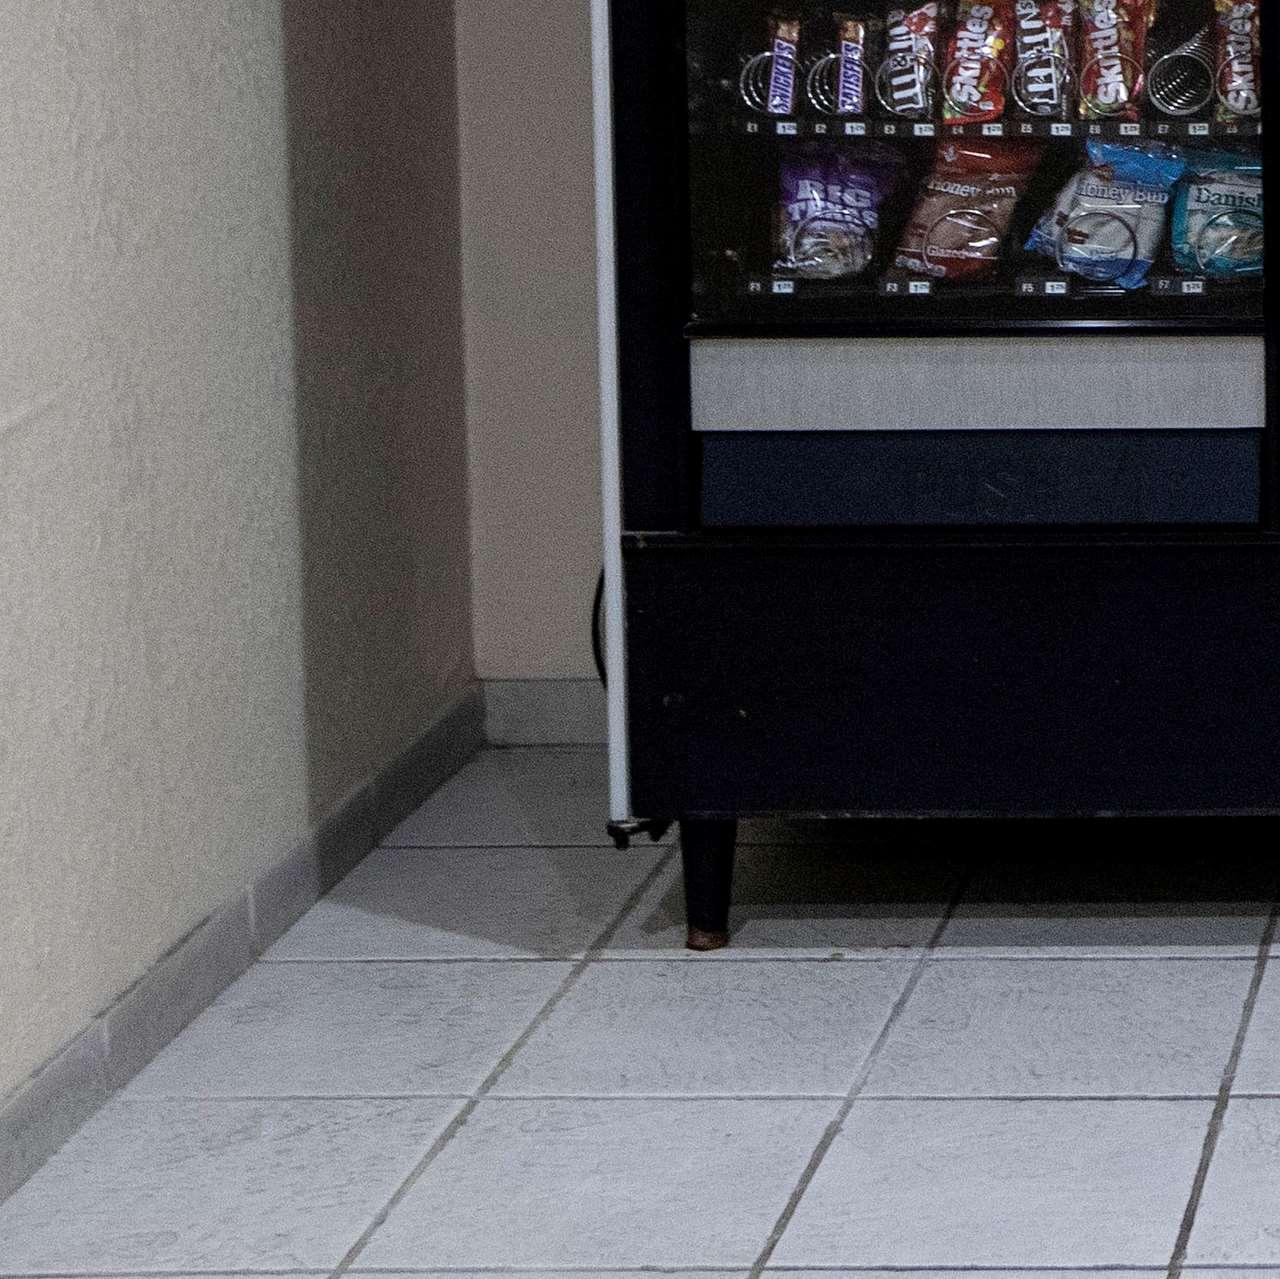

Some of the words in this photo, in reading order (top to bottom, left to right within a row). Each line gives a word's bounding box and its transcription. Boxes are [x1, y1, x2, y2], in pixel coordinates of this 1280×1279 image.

[767, 40, 795, 114] SNICKERS
[949, 4, 993, 103] Skittles
[797, 179, 871, 208] BIG
[1134, 189, 1169, 205] Bun
